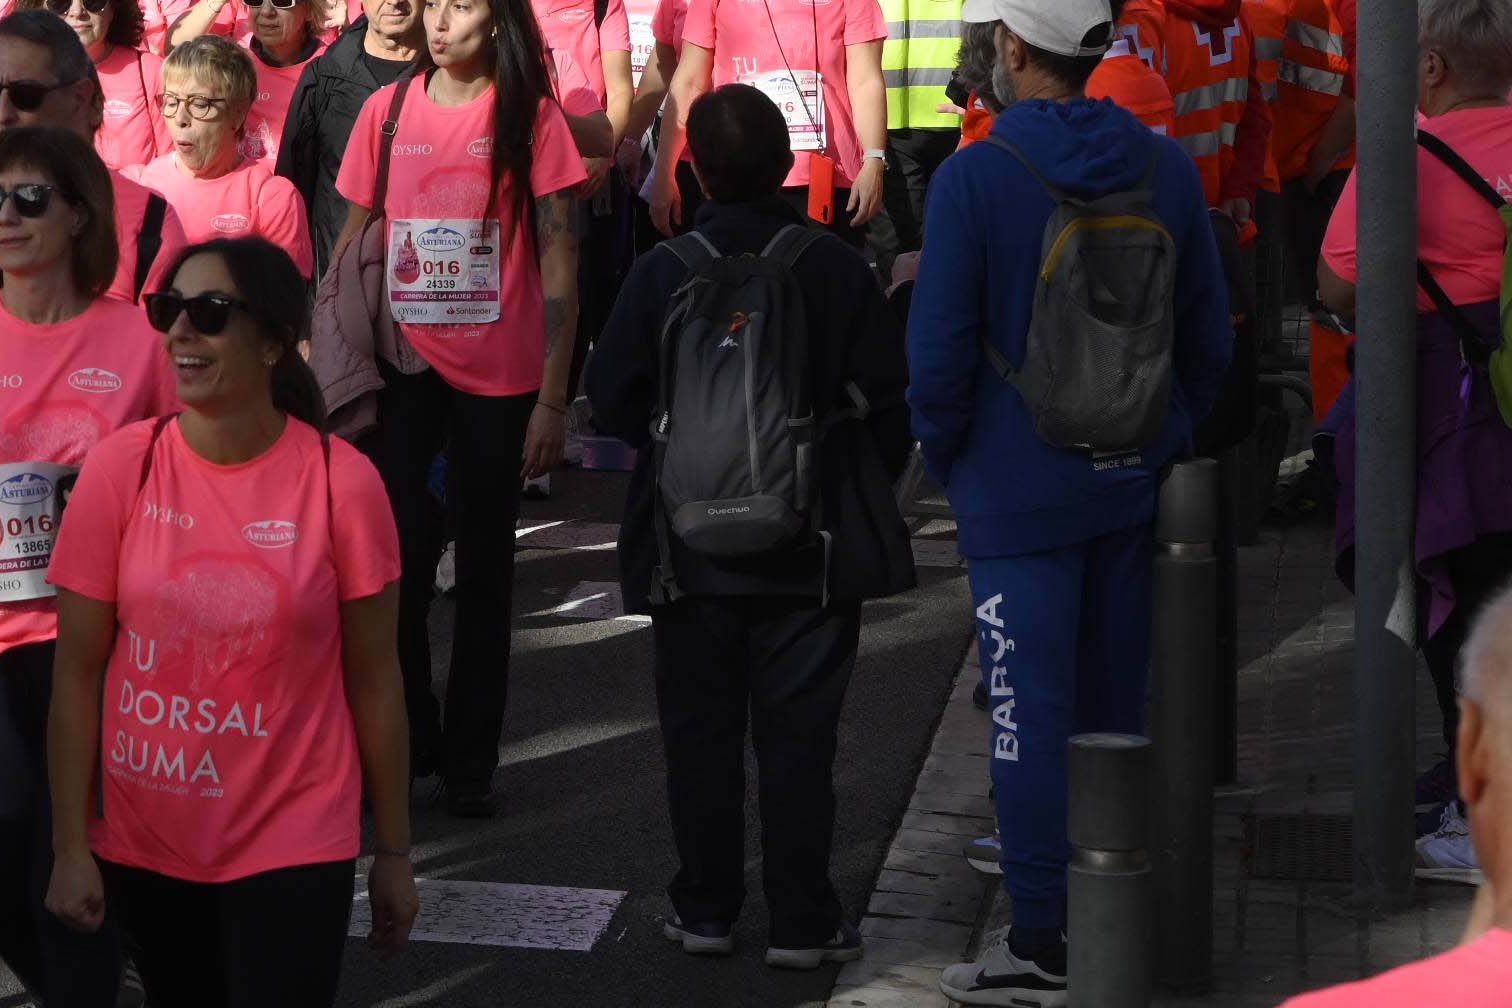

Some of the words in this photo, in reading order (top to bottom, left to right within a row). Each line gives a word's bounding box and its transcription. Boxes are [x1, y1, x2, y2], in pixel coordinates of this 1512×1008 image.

[732, 56, 758, 77] TU
[392, 144, 433, 156] OYSHO
[420, 236, 463, 247] ASTURIANA
[422, 259, 460, 276] 016
[426, 279, 456, 289] 24339
[400, 292, 428, 300] CARRERA
[428, 292, 437, 300] DE
[437, 292, 447, 300] LA
[448, 292, 471, 300] MUJER
[455, 306, 492, 316] Santander
[1093, 461, 1121, 471] SINCE
[7, 514, 54, 537] 016
[14, 541, 51, 554] 13865
[20, 559, 32, 568] DE
[33, 557, 45, 567] LA
[128, 628, 156, 673] TU
[976, 593, 1019, 762] BARÇA
[119, 679, 269, 738] DORSAL
[110, 729, 221, 785] SUMA
